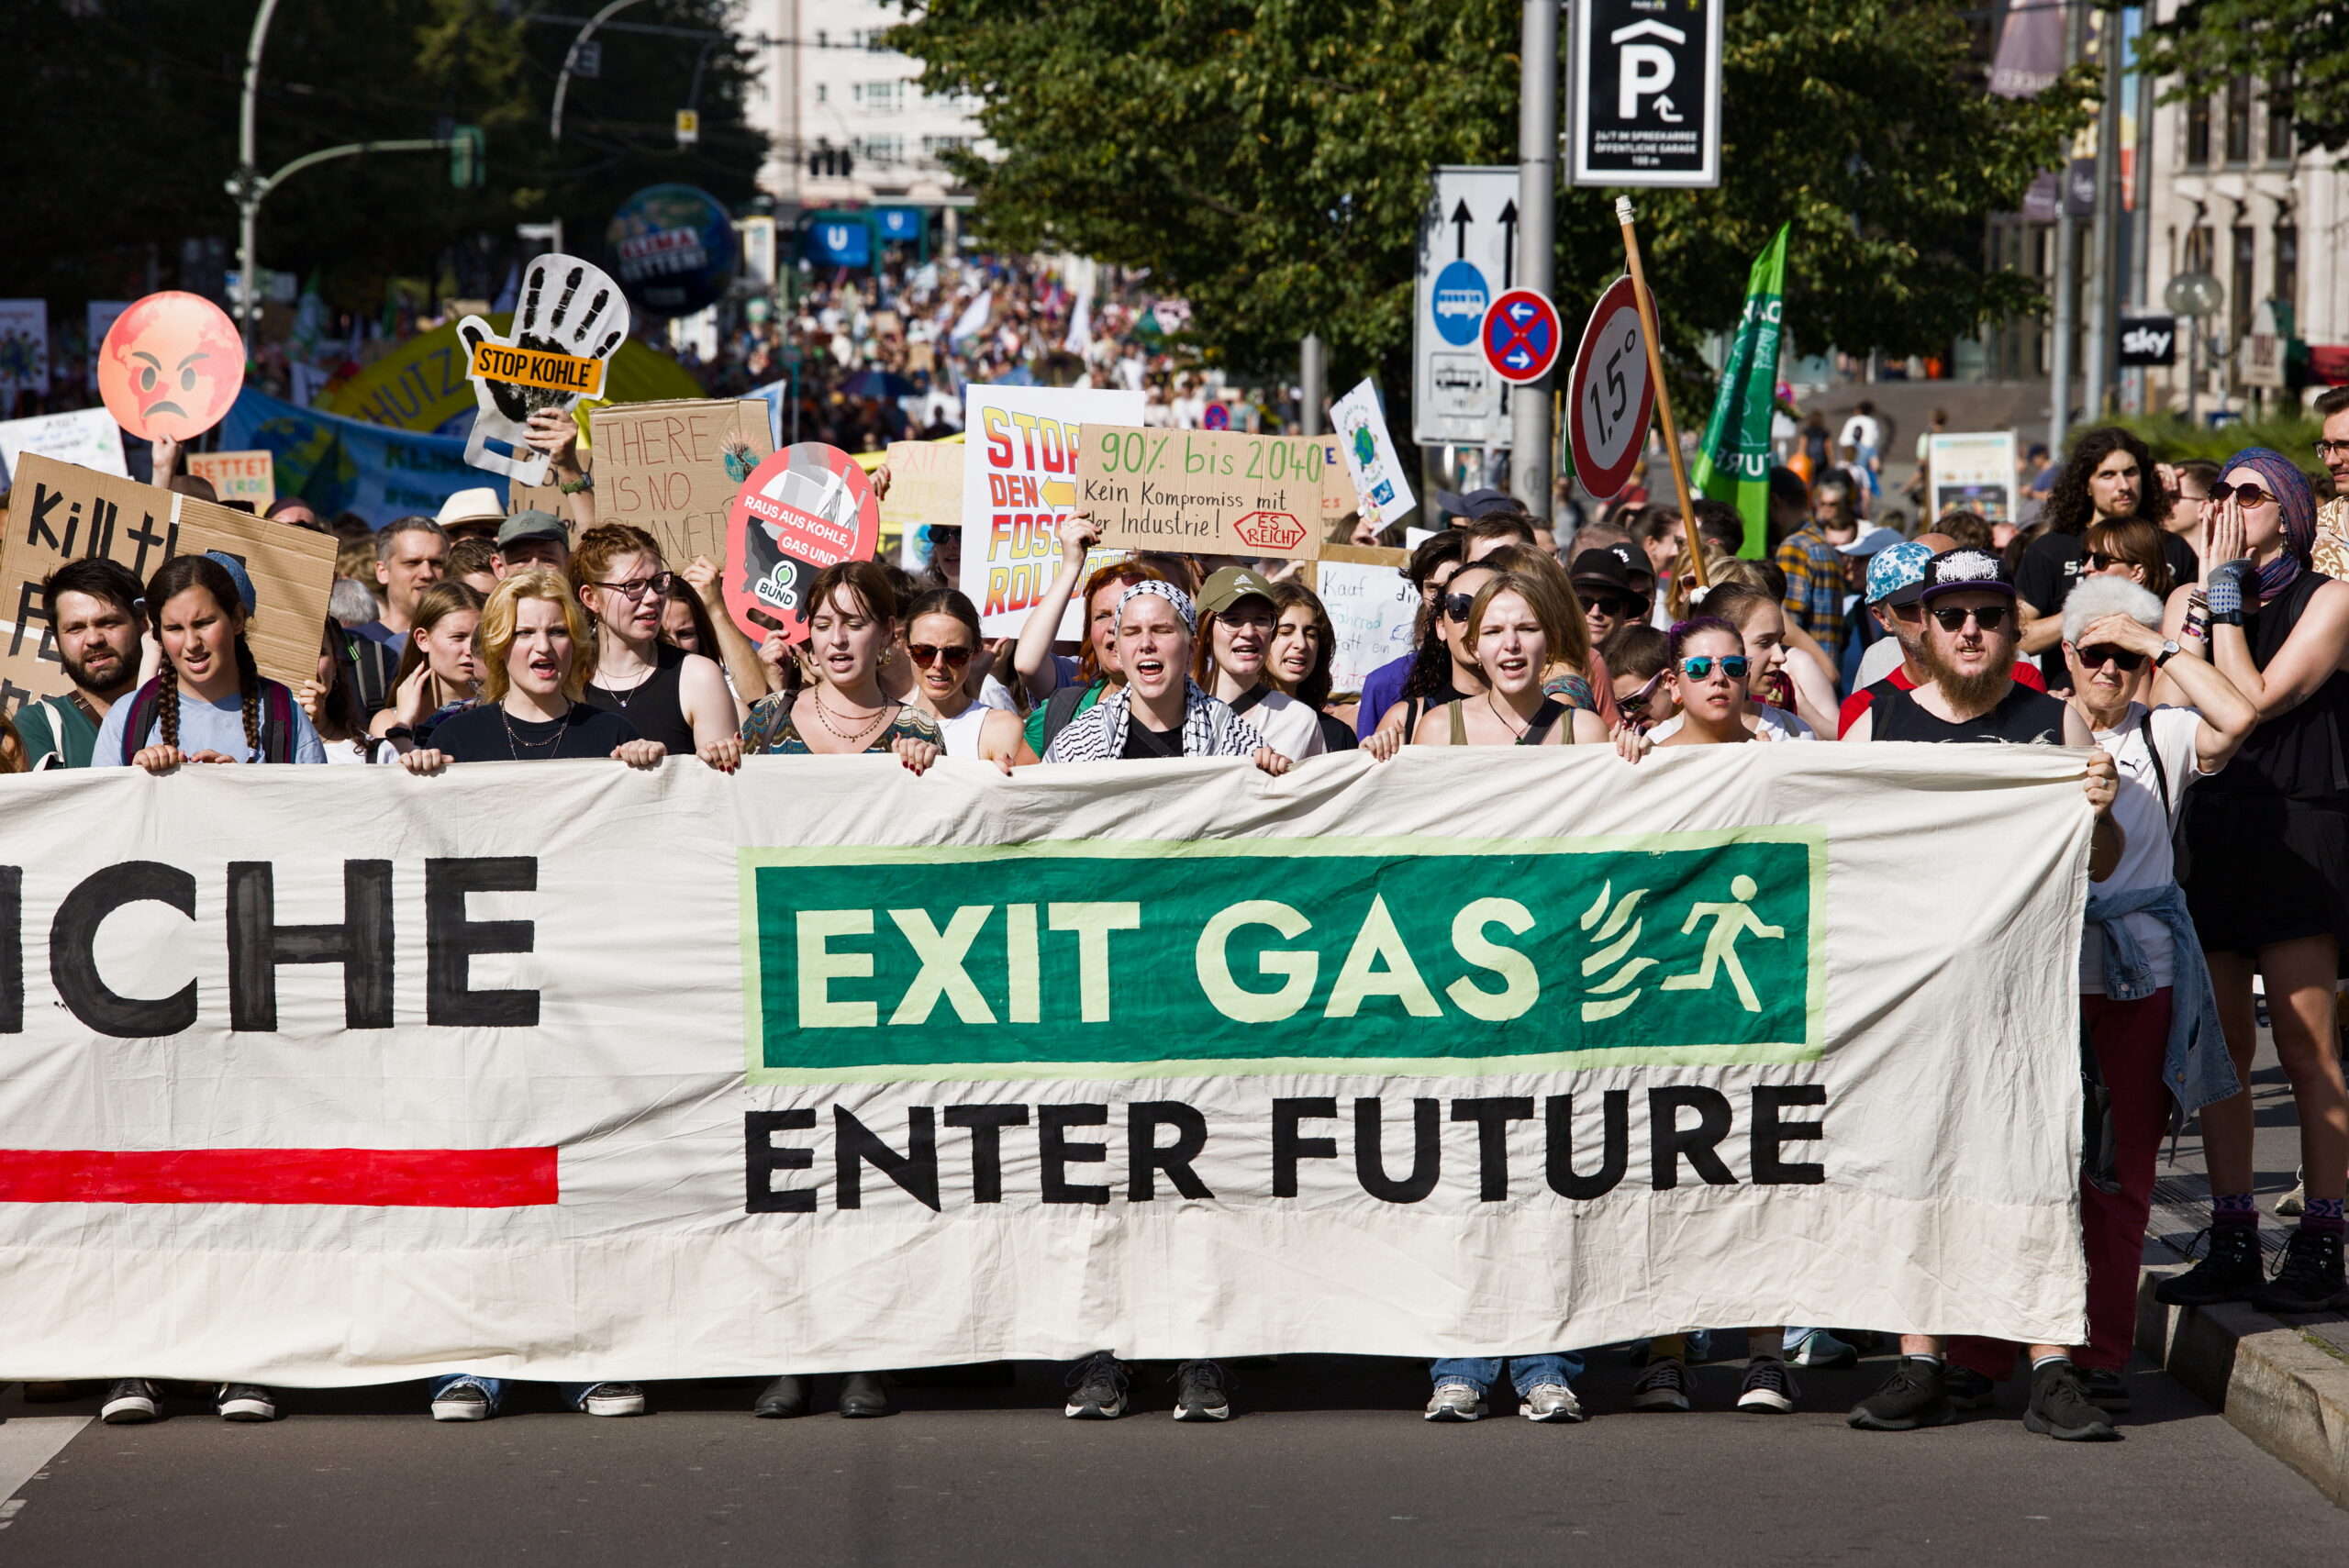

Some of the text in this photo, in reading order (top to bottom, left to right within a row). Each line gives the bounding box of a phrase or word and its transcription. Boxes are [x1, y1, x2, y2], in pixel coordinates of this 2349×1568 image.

[1619, 45, 1675, 119] P
[1594, 142, 1698, 154] ÖFFENTLICHE GARAGE
[1595, 130, 1617, 141] 24/7
[887, 211, 904, 231] U
[828, 226, 848, 251] U
[2121, 326, 2172, 358] sky
[479, 348, 592, 387] STOP KOHLE
[596, 417, 713, 467] THERE
[192, 457, 268, 479] RETTET
[886, 444, 948, 473] EXIT
[1101, 432, 1323, 484] 90% bis 2040
[611, 472, 691, 513] IS NO
[987, 473, 1040, 507] DEN
[1085, 478, 1287, 511] Kein Kompromiss mit
[744, 495, 850, 549] RAUS AUS KOHLE,
[1121, 507, 1220, 539] Industrie!
[1247, 528, 1300, 546] REICHT
[1258, 515, 1280, 529] ES
[782, 536, 809, 556] GAS
[809, 547, 837, 566] UND
[759, 582, 793, 606] BUND
[1323, 570, 1368, 597] Kauf
[1326, 603, 1383, 631] Fahrrad
[1334, 630, 1390, 654] tatt ein
[796, 892, 1541, 1029] EXIT GAS
[744, 1084, 1827, 1215] ENTER FUTURE
